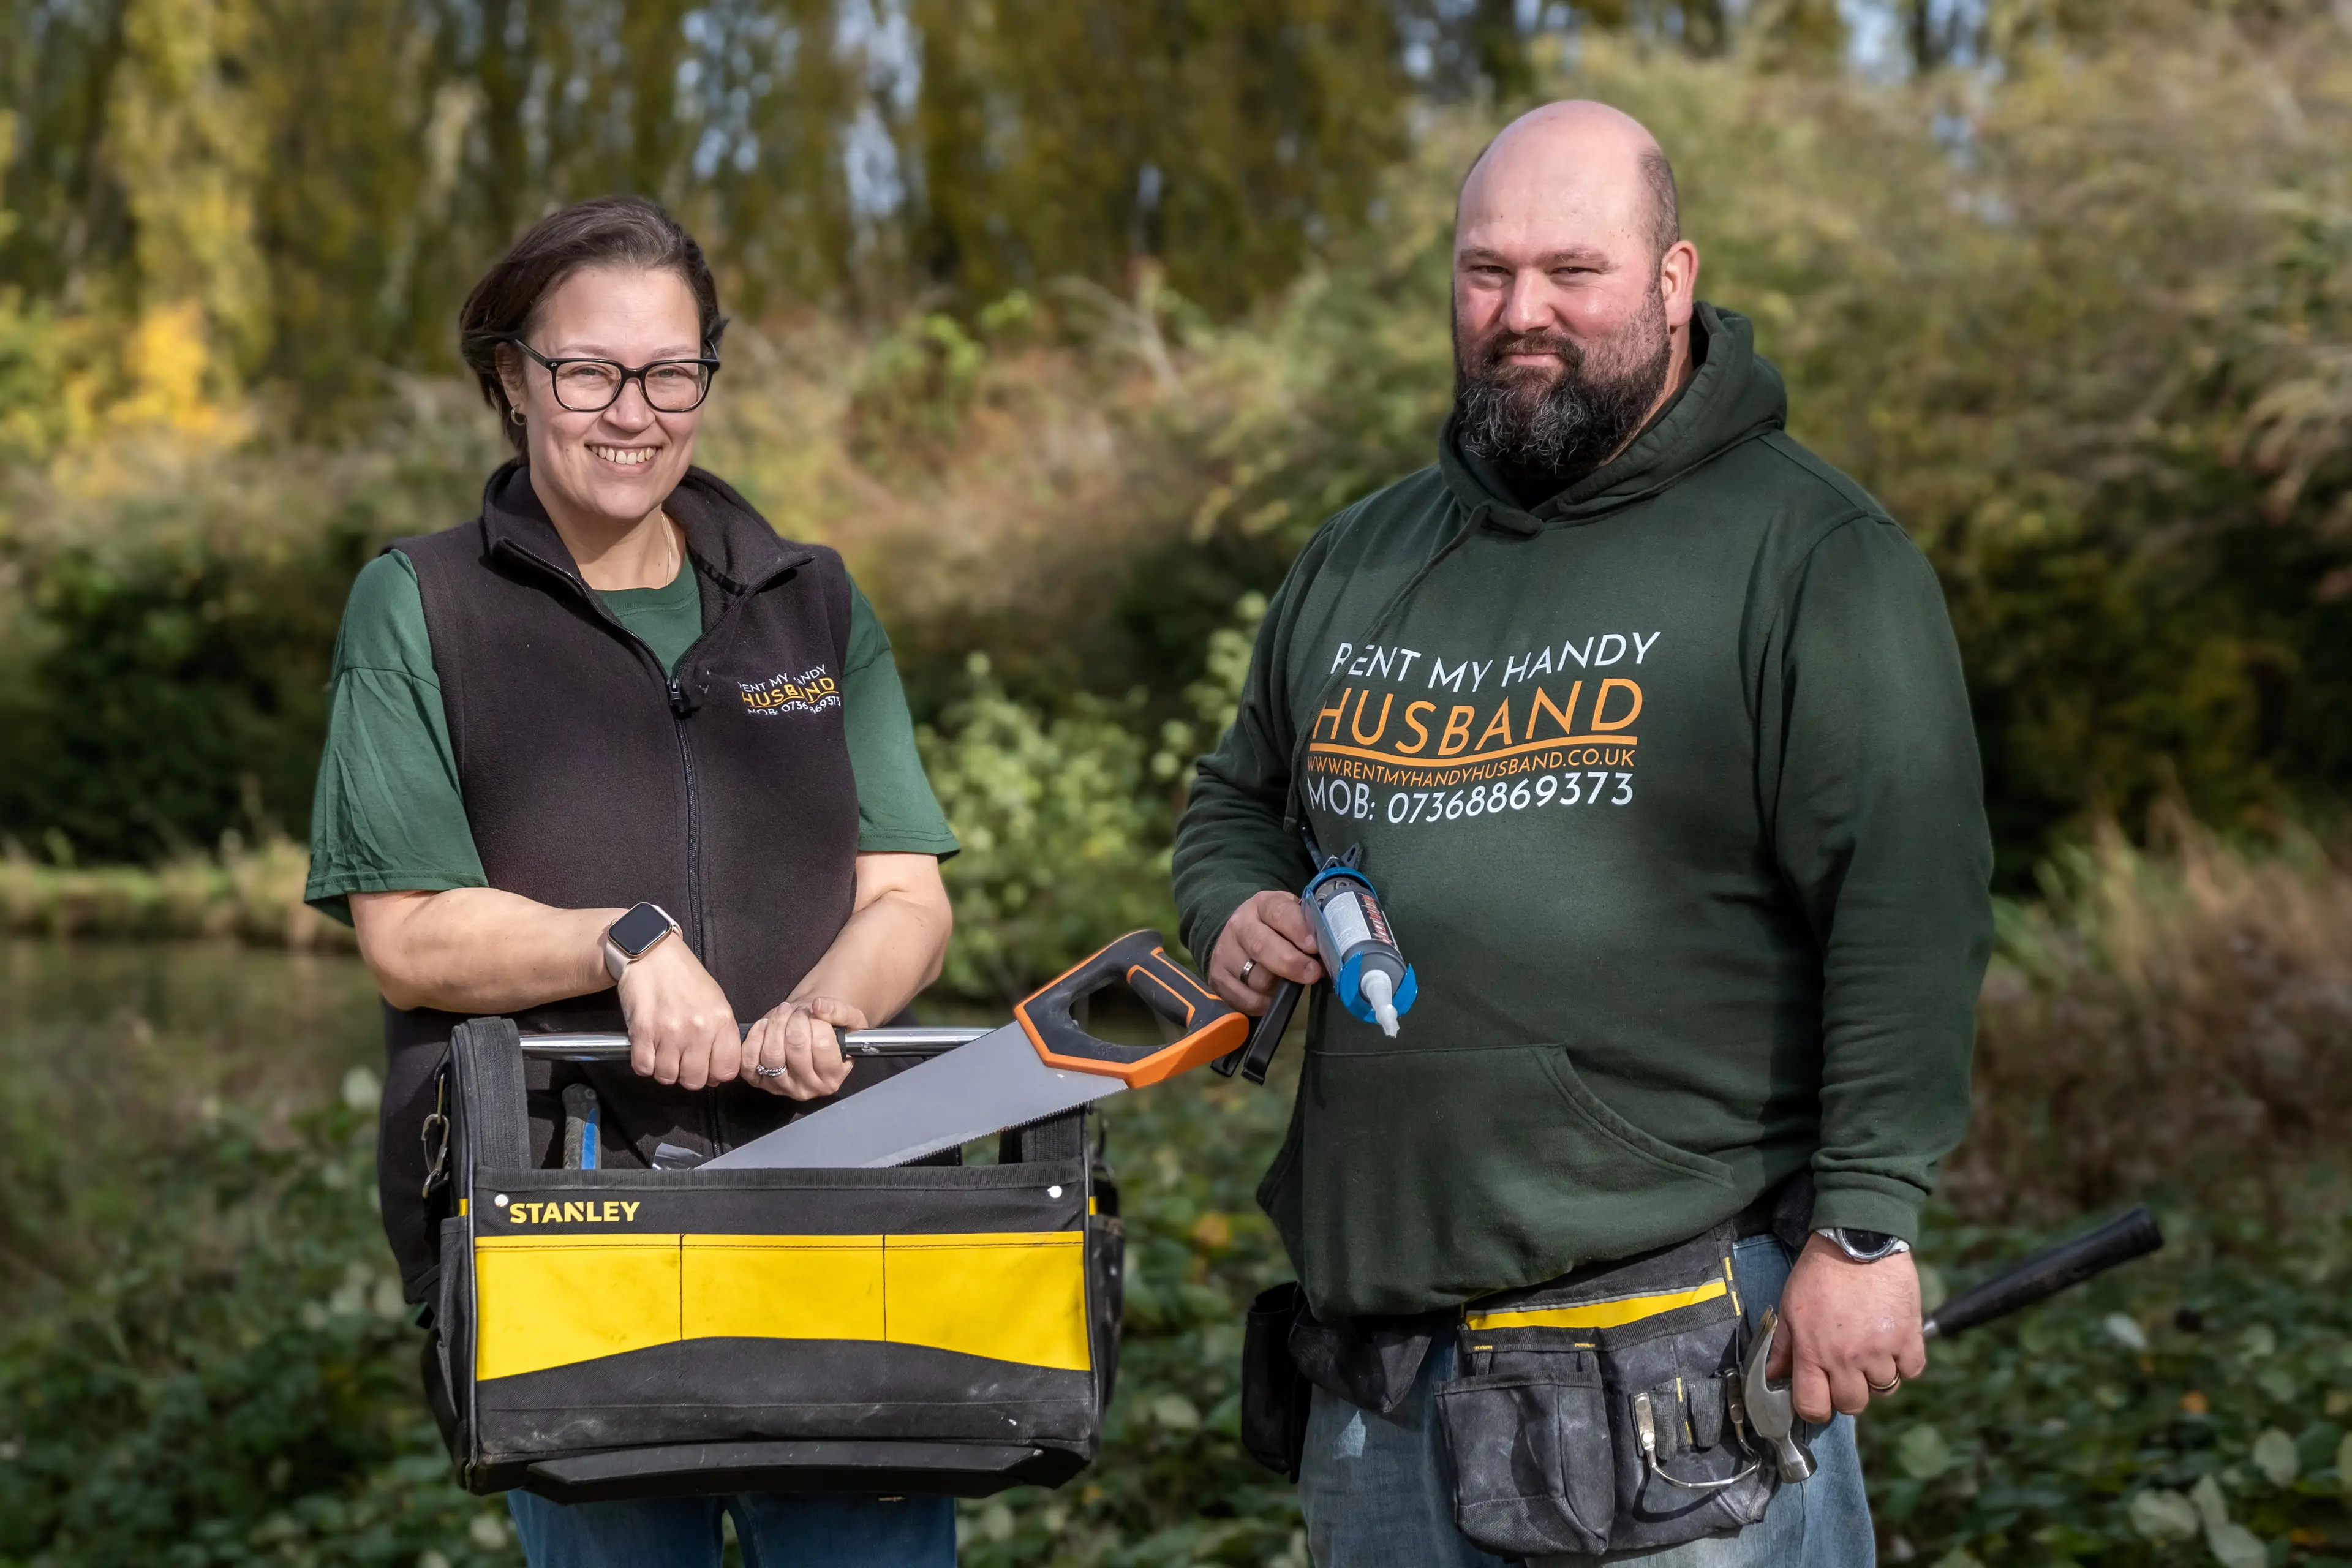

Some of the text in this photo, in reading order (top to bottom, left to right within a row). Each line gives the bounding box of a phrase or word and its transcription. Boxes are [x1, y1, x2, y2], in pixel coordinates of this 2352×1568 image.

[737, 663, 826, 693] ENT MY NDY
[1330, 631, 1661, 692] RENT MY HANDY
[1312, 677, 1643, 756] HUSBAND
[1307, 748, 1635, 787] WWW.RENTMYHANDYHUSBAND.CO.UK
[1307, 772, 1634, 824] MOB: 07368869373
[509, 1200, 641, 1224] STANLEY
